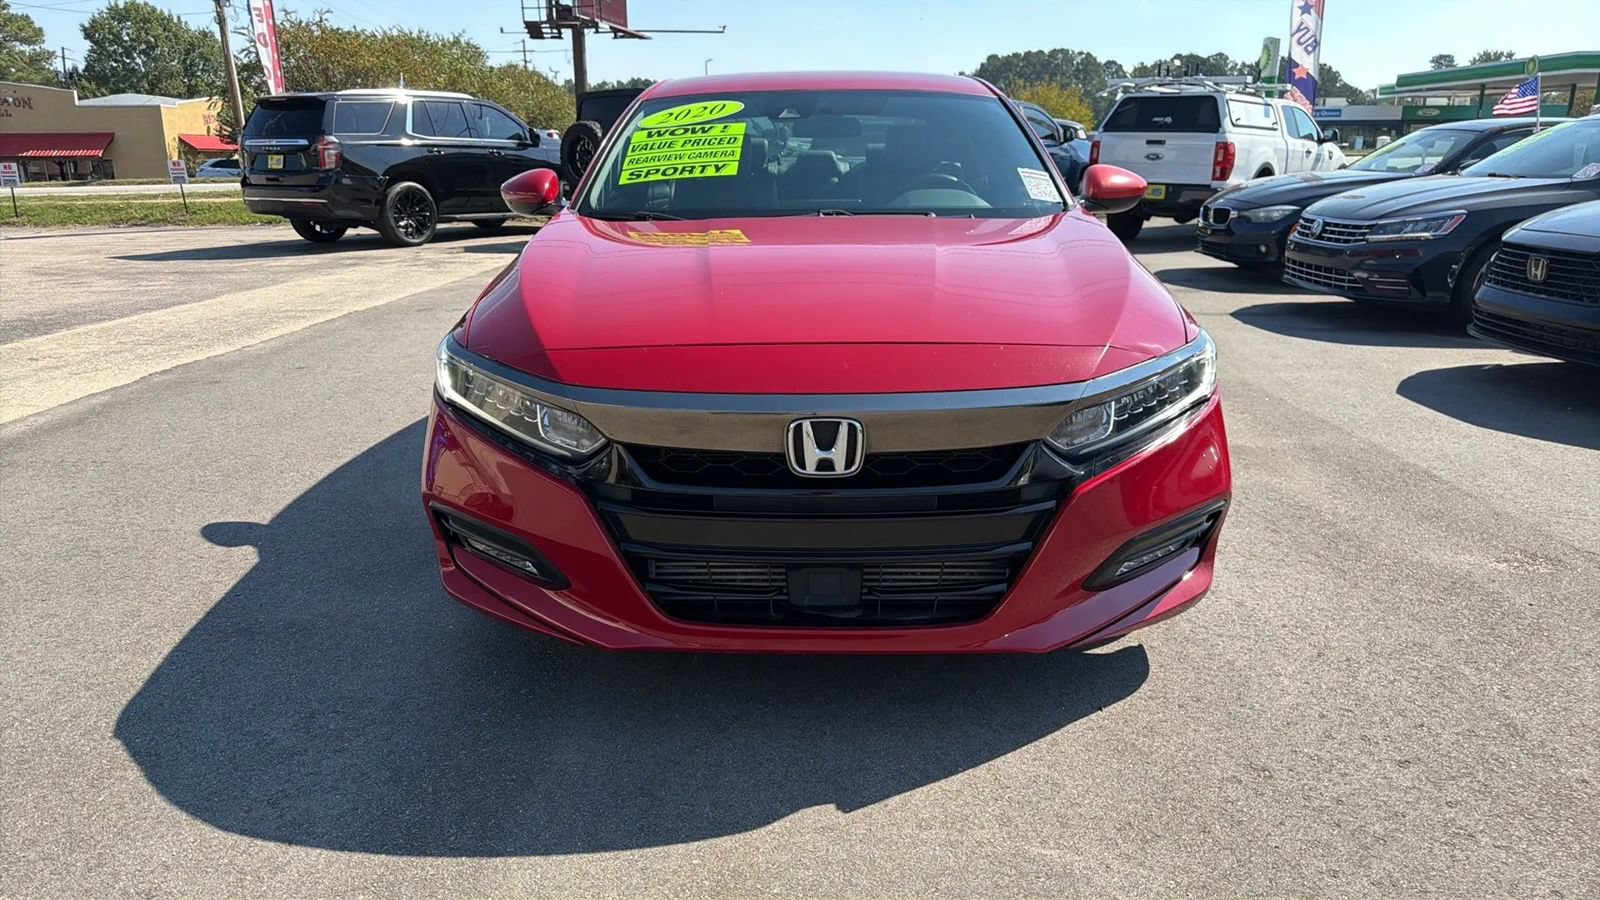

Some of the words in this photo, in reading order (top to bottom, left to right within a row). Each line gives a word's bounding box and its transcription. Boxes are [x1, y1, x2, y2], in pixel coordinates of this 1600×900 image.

[657, 103, 726, 125] 2020
[646, 125, 714, 138] WOW
[631, 140, 676, 153] VALUE
[682, 137, 738, 148] PRICED
[626, 153, 687, 167] REARVIEW
[687, 149, 736, 160] CAMERA
[627, 163, 728, 180] SPORTY
